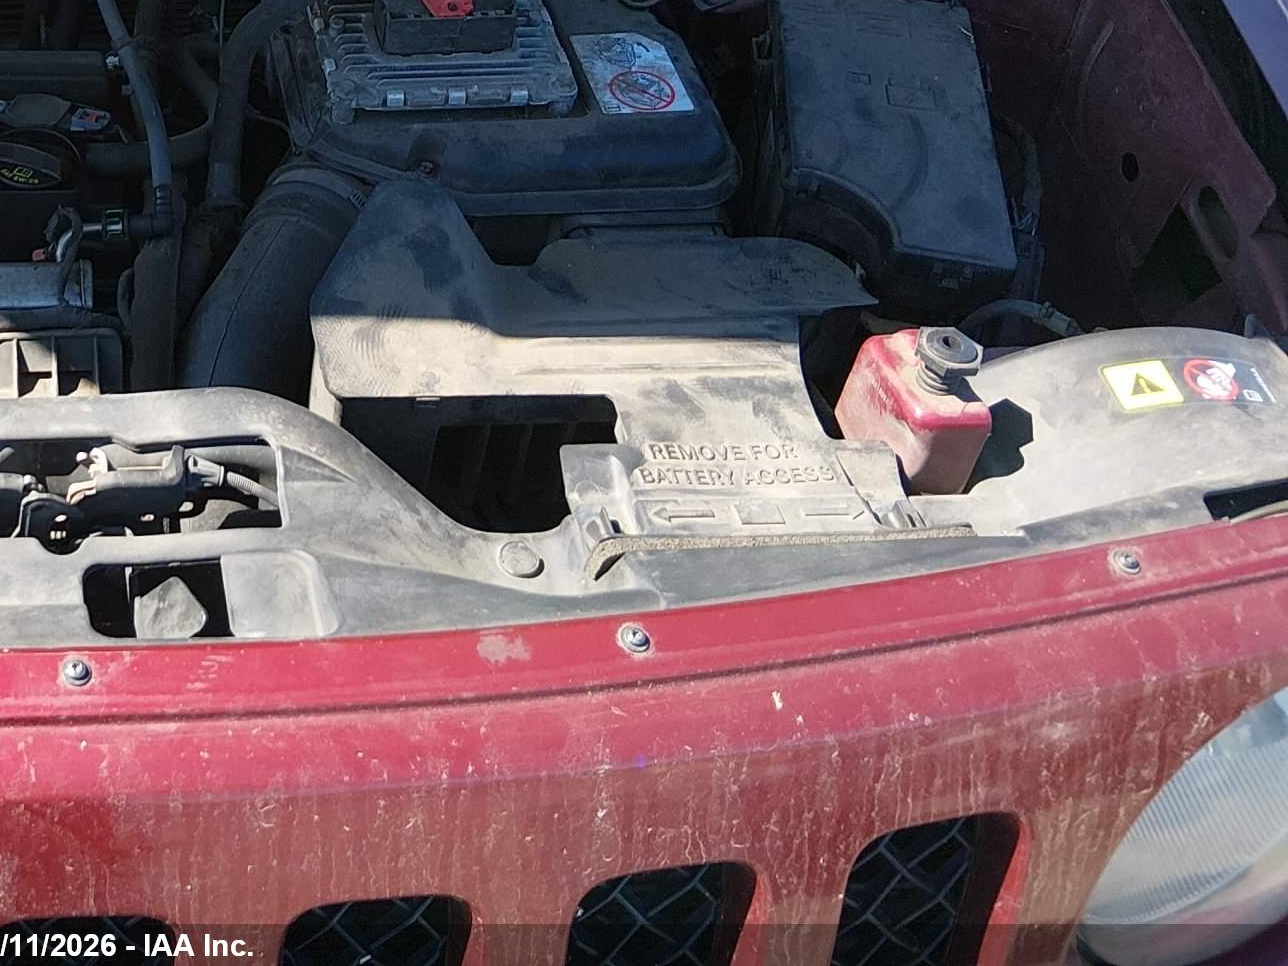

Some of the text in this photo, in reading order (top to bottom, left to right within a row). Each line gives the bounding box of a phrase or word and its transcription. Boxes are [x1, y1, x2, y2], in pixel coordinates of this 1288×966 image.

[649, 442, 798, 461] REMOVE FOR
[640, 465, 835, 485] BATTERY ACCESS
